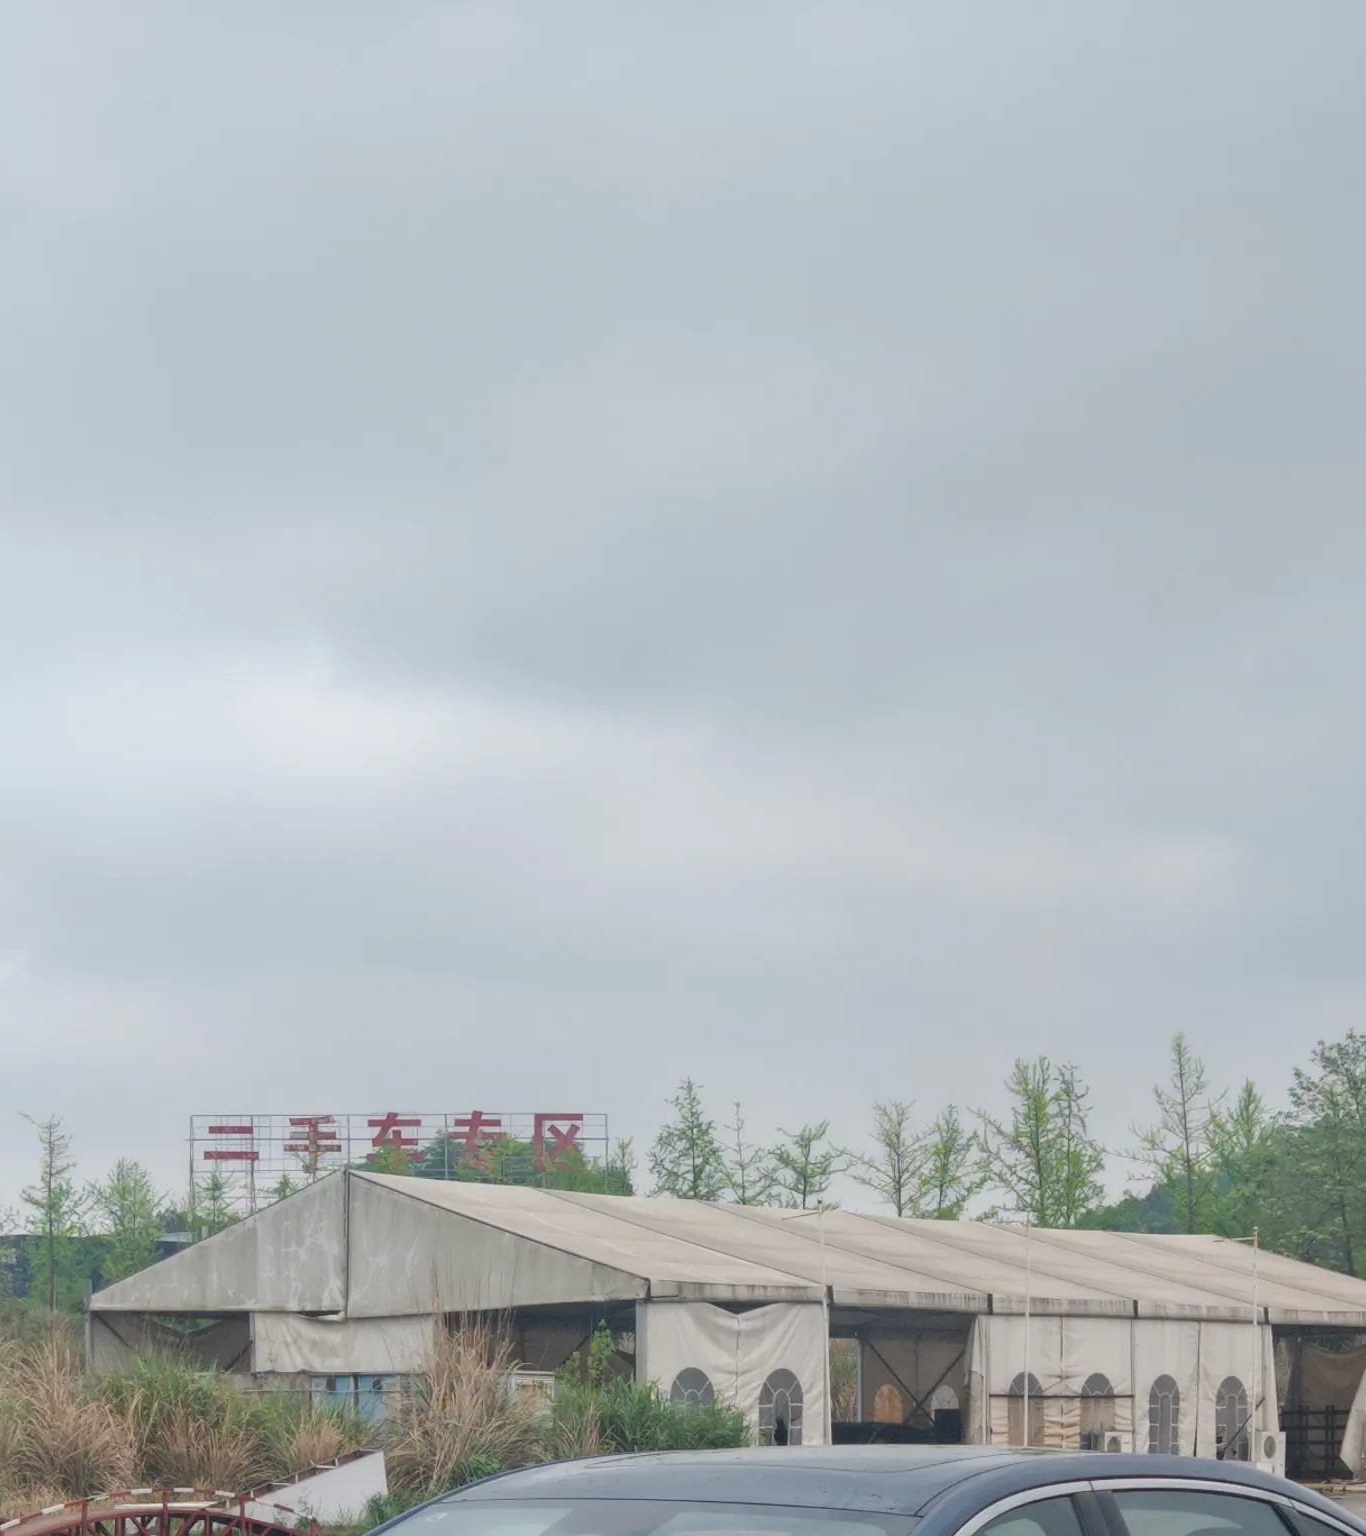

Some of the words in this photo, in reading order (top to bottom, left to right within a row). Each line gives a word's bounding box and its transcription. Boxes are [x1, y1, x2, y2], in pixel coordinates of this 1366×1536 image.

[203, 1110, 585, 1174] 二手车专区
